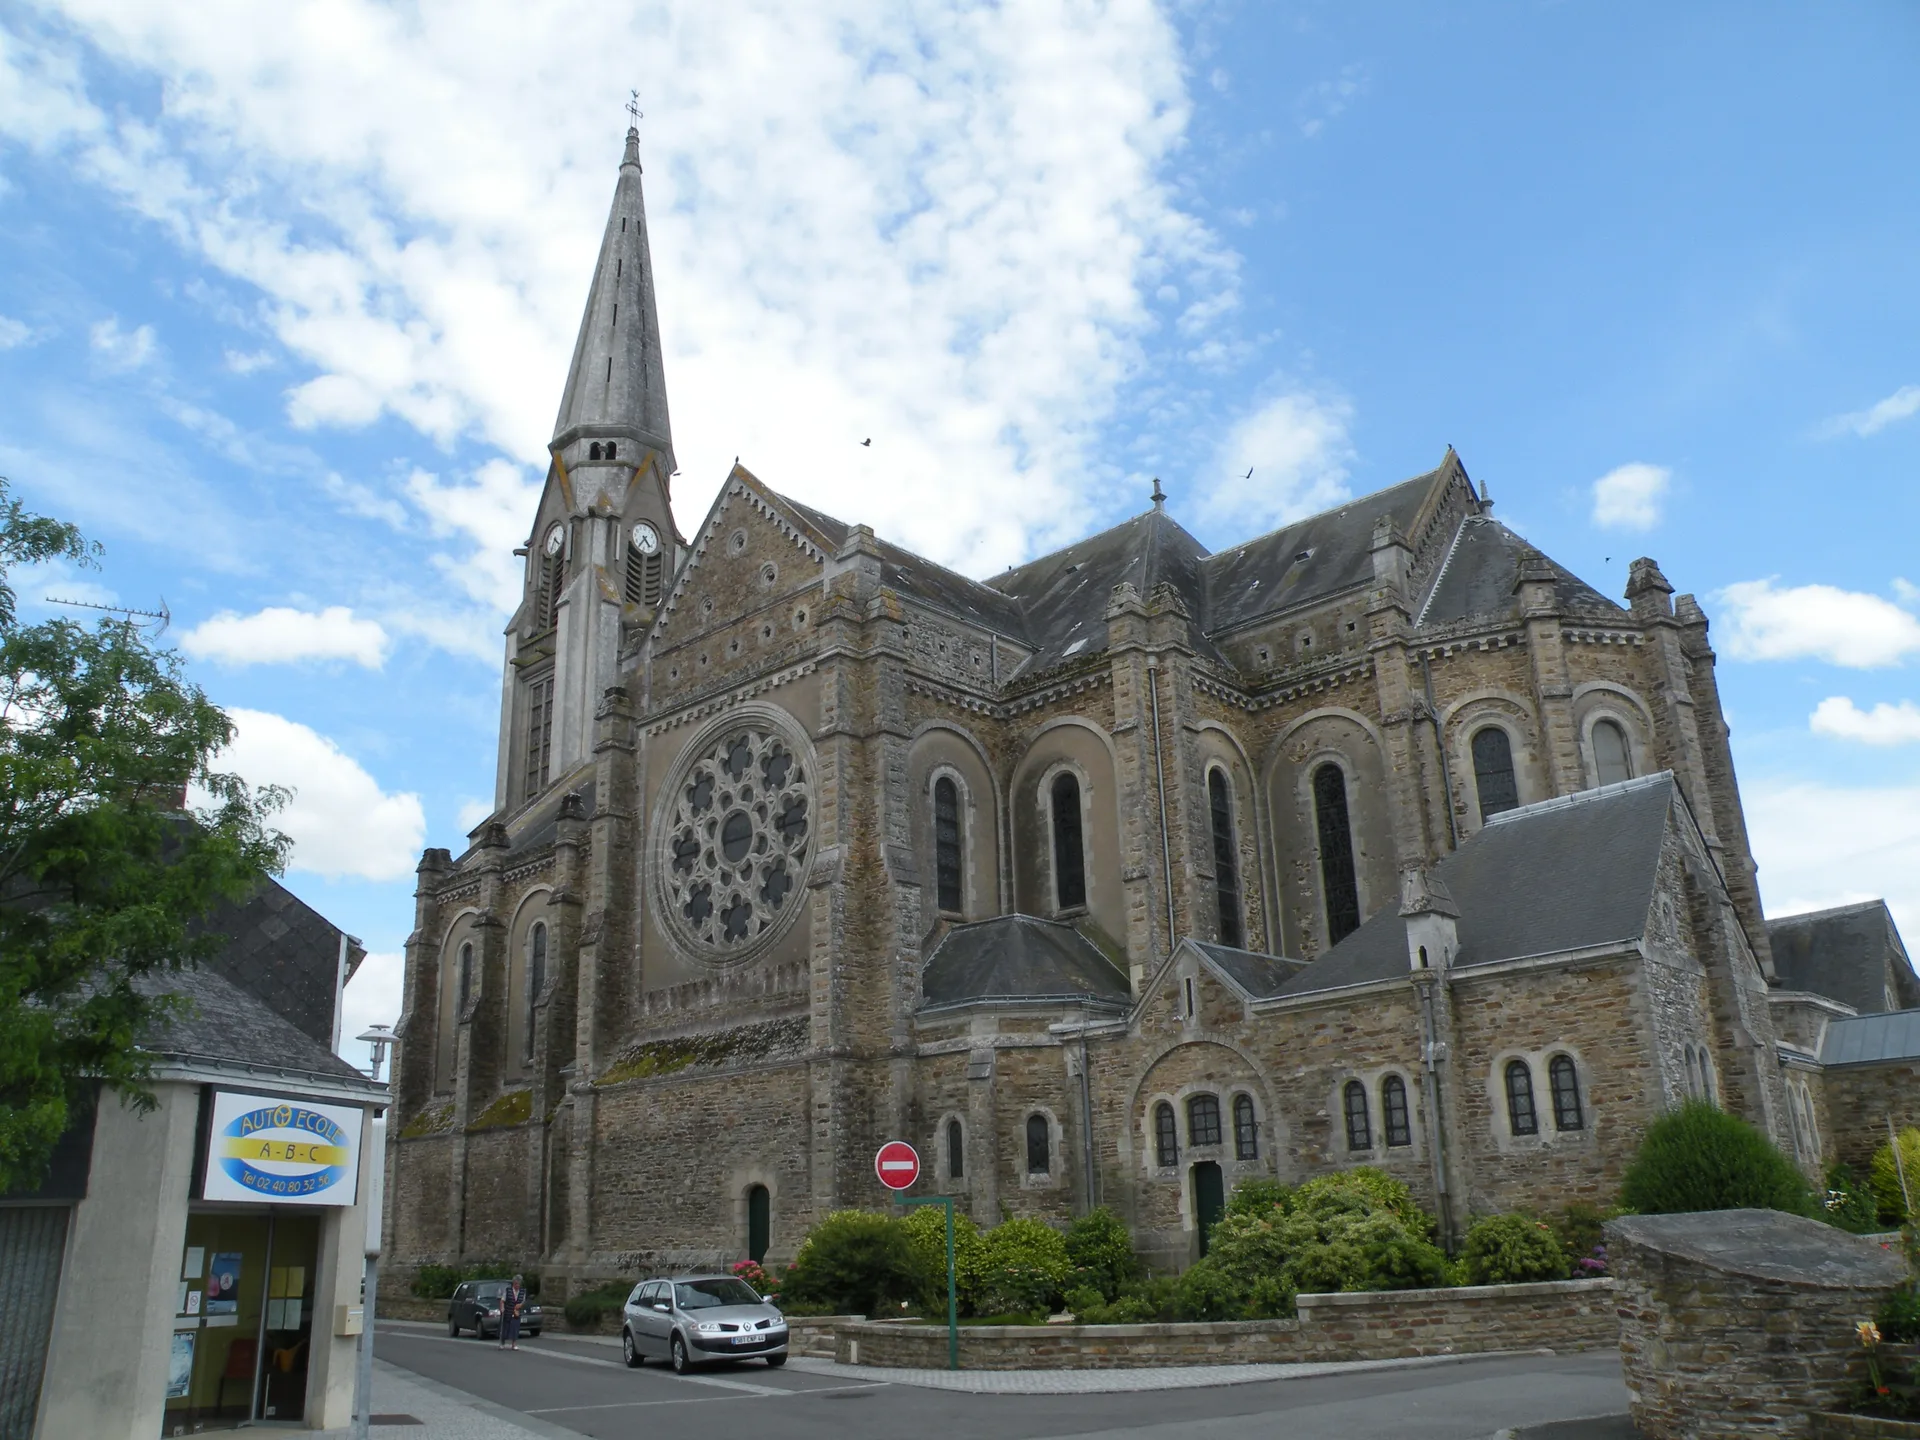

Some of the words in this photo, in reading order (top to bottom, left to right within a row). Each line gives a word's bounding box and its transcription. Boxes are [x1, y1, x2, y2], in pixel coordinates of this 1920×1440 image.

[241, 1105, 292, 1136] AUTO
[296, 1111, 344, 1144] ECOLE
[260, 1143, 271, 1158] A
[286, 1145, 296, 1160] B
[309, 1147, 319, 1161] C
[242, 1170, 256, 1185] Tel
[256, 1176, 271, 1190] 02
[272, 1180, 286, 1192] 40
[287, 1180, 301, 1192] 80
[302, 1178, 315, 1192] 32
[318, 1173, 329, 1187] 56
